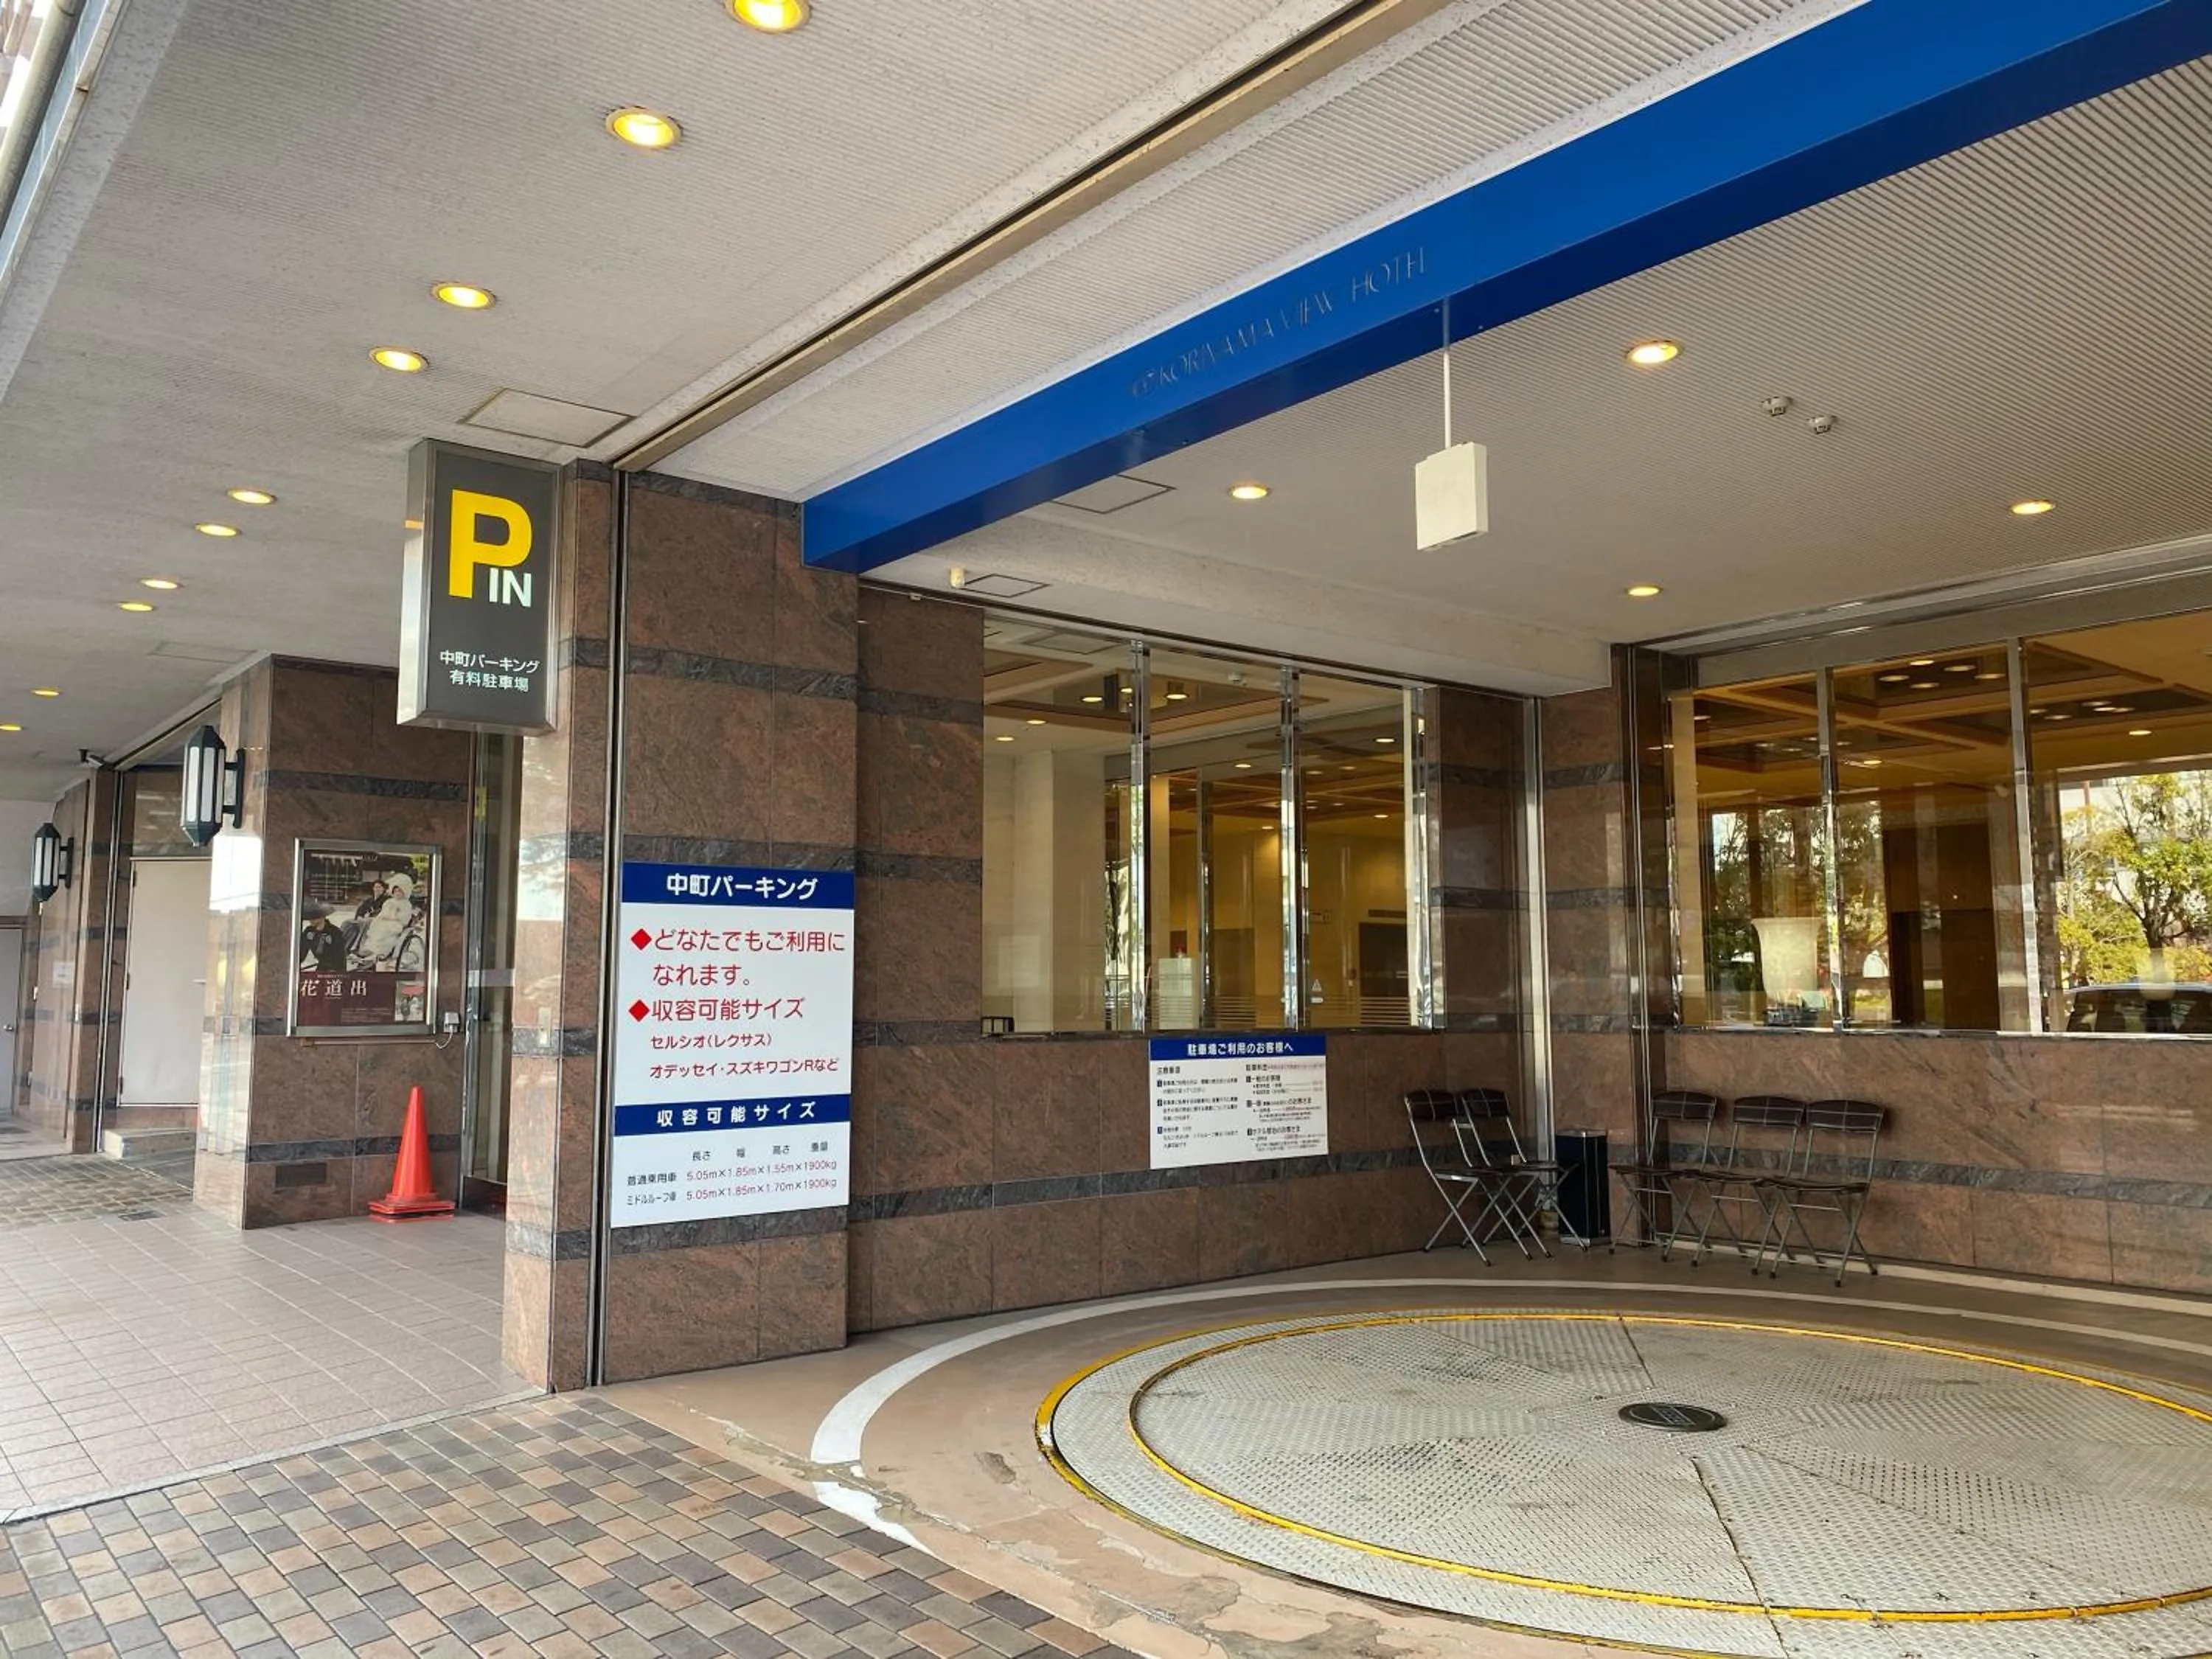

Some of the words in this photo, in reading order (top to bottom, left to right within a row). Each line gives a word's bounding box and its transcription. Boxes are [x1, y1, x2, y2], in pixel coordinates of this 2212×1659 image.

[448, 489, 532, 599] P
[489, 568, 532, 607] IN
[439, 650, 540, 673] 中町パーキング
[449, 669, 529, 692] 有料駐車場
[667, 873, 818, 900] 中町パーキング
[654, 928, 846, 952] どなたでもご利用に
[653, 964, 751, 986] なれます。
[652, 998, 805, 1022] 収容可能サイズ
[657, 1102, 815, 1127] 収容可能サイズ
